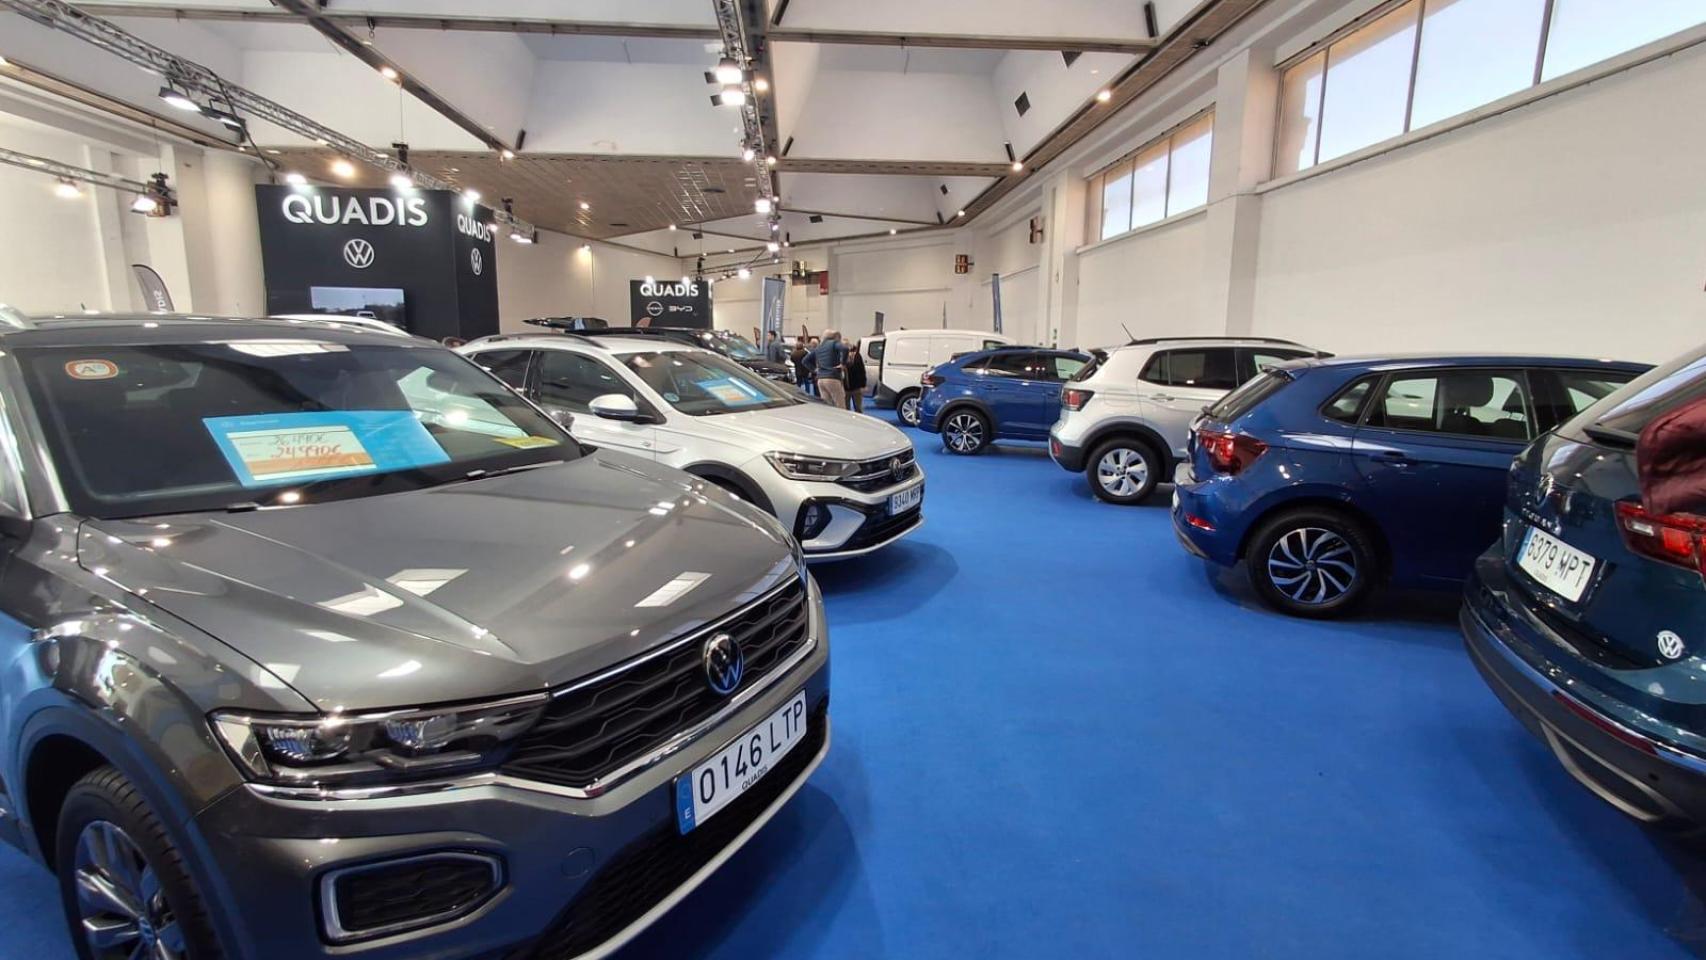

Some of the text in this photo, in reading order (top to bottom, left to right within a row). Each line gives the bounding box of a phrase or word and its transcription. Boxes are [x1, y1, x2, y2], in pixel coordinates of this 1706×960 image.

[281, 194, 429, 227] QUADIS
[457, 213, 492, 244] QUADIS
[639, 283, 699, 297] QUADIS
[1527, 533, 1591, 588] 6379 MPT
[684, 699, 805, 819] E 0146 LTP
[740, 765, 769, 791] QUADIS
